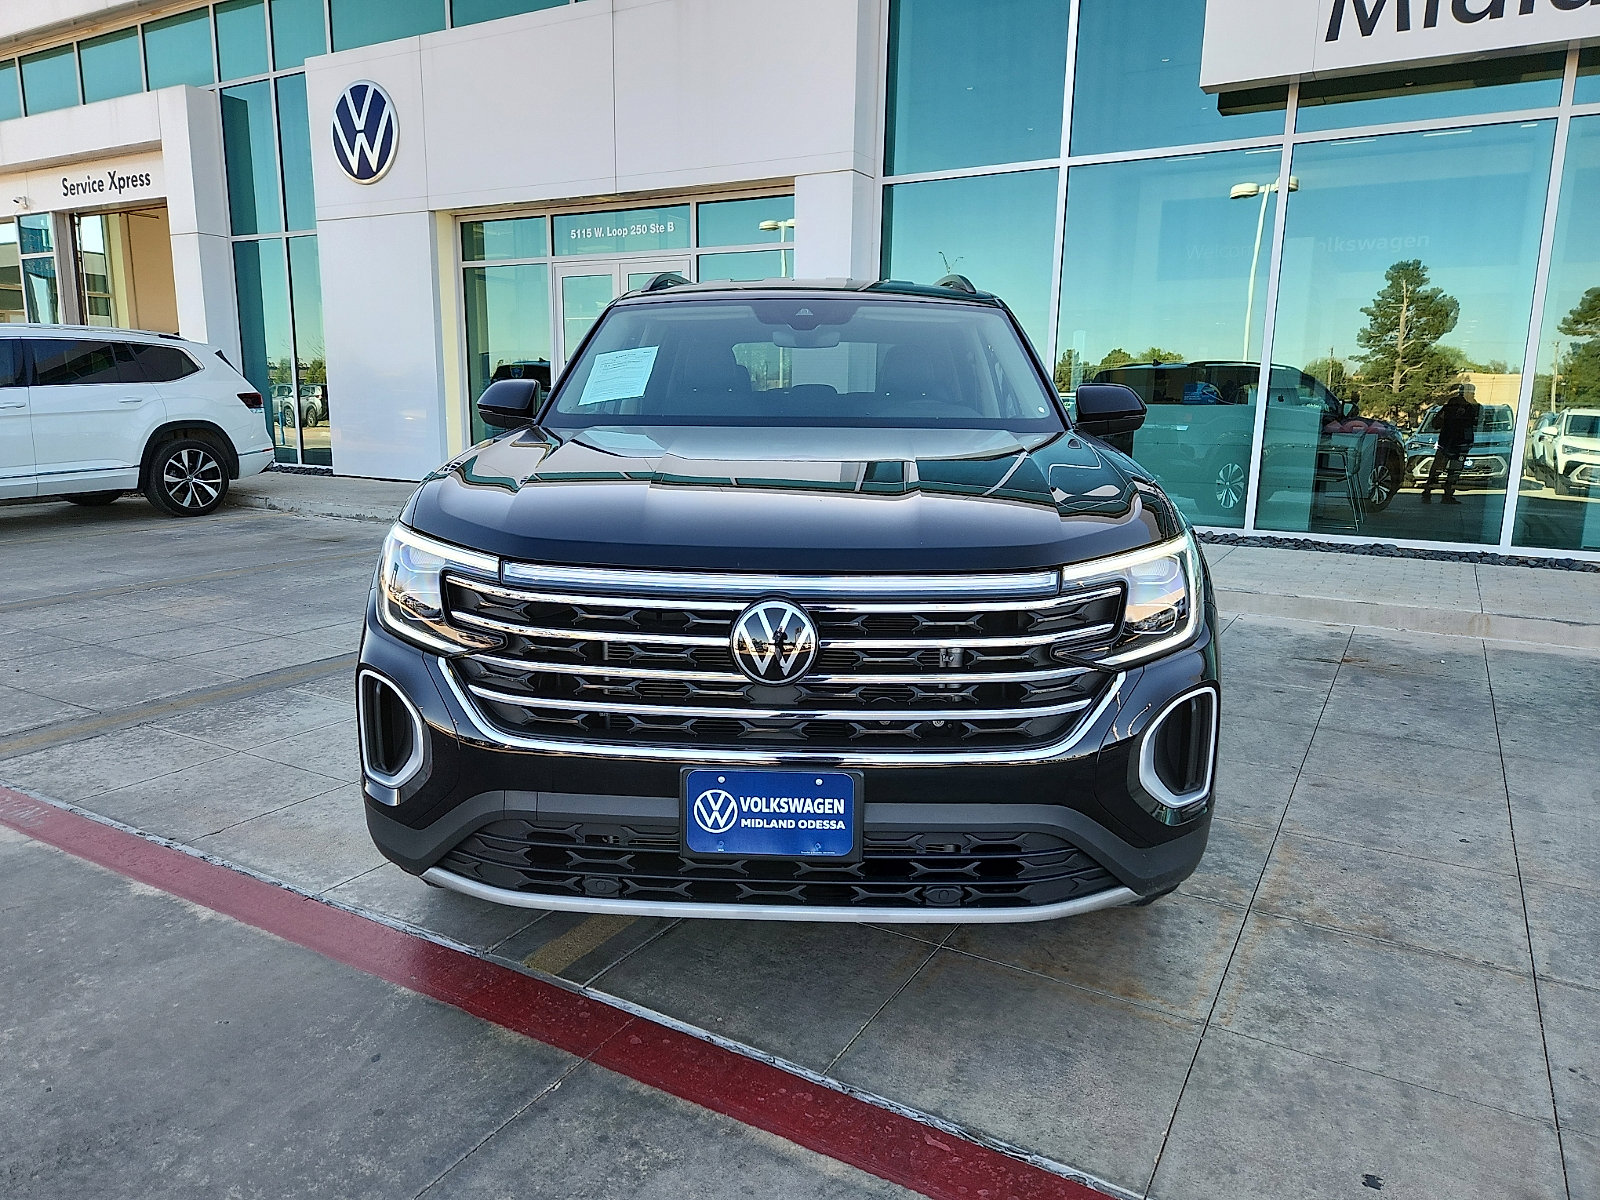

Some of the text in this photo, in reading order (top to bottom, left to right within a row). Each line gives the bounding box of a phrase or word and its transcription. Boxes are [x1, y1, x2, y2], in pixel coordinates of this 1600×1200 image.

[62, 170, 151, 197] Service Xpress
[570, 221, 675, 239] 5115 W. Loop 250 Ste B
[739, 796, 845, 814] VOLKSWAGEN
[740, 818, 846, 830] MIDLAND ODESSA
